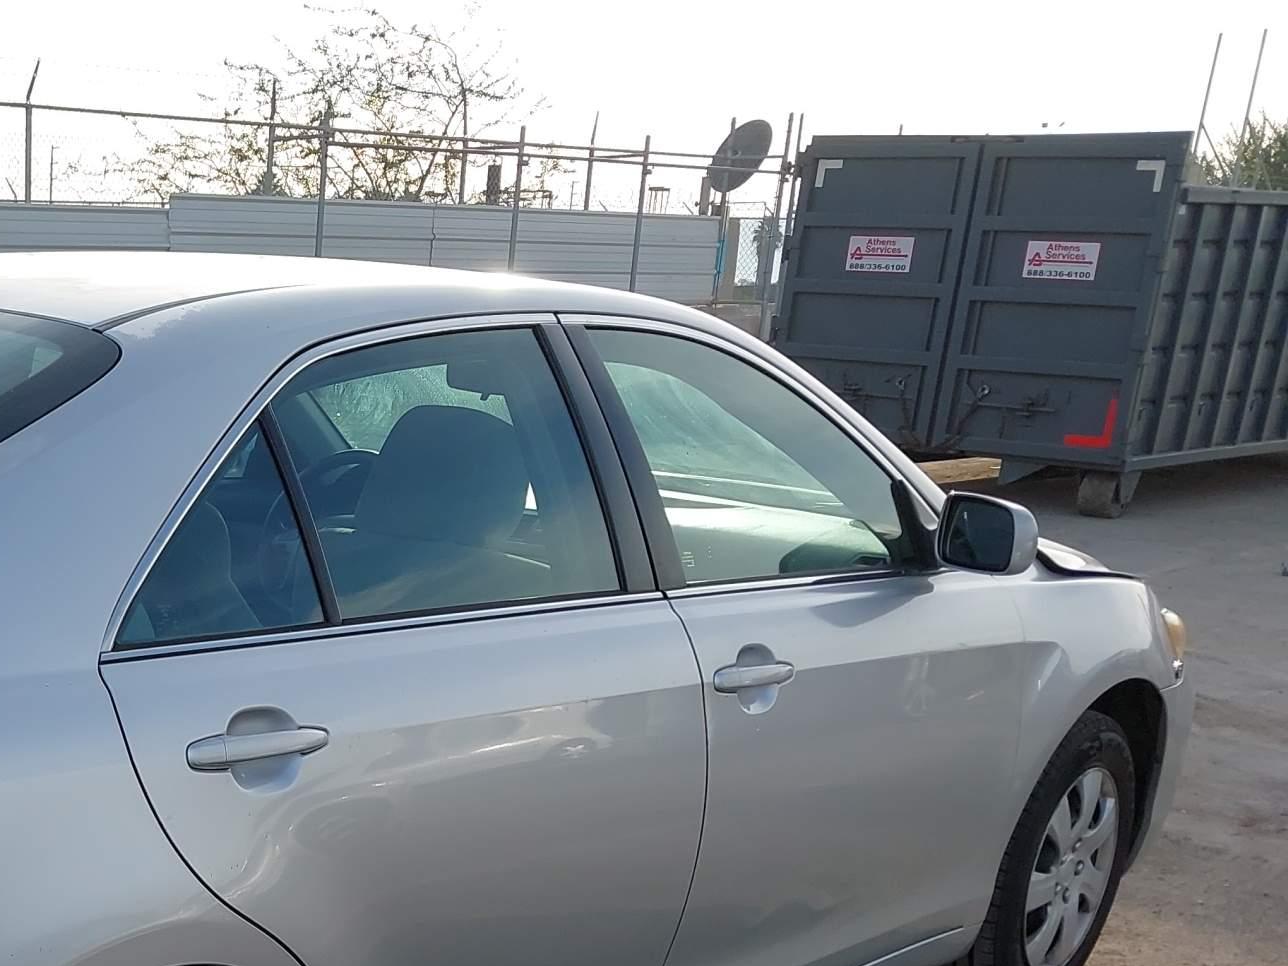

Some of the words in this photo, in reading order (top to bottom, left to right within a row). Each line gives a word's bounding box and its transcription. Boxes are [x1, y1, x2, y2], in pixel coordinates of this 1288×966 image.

[866, 238, 897, 246] Athens
[864, 245, 902, 254] Services
[1047, 243, 1081, 252] Athens
[1045, 251, 1087, 260] Services
